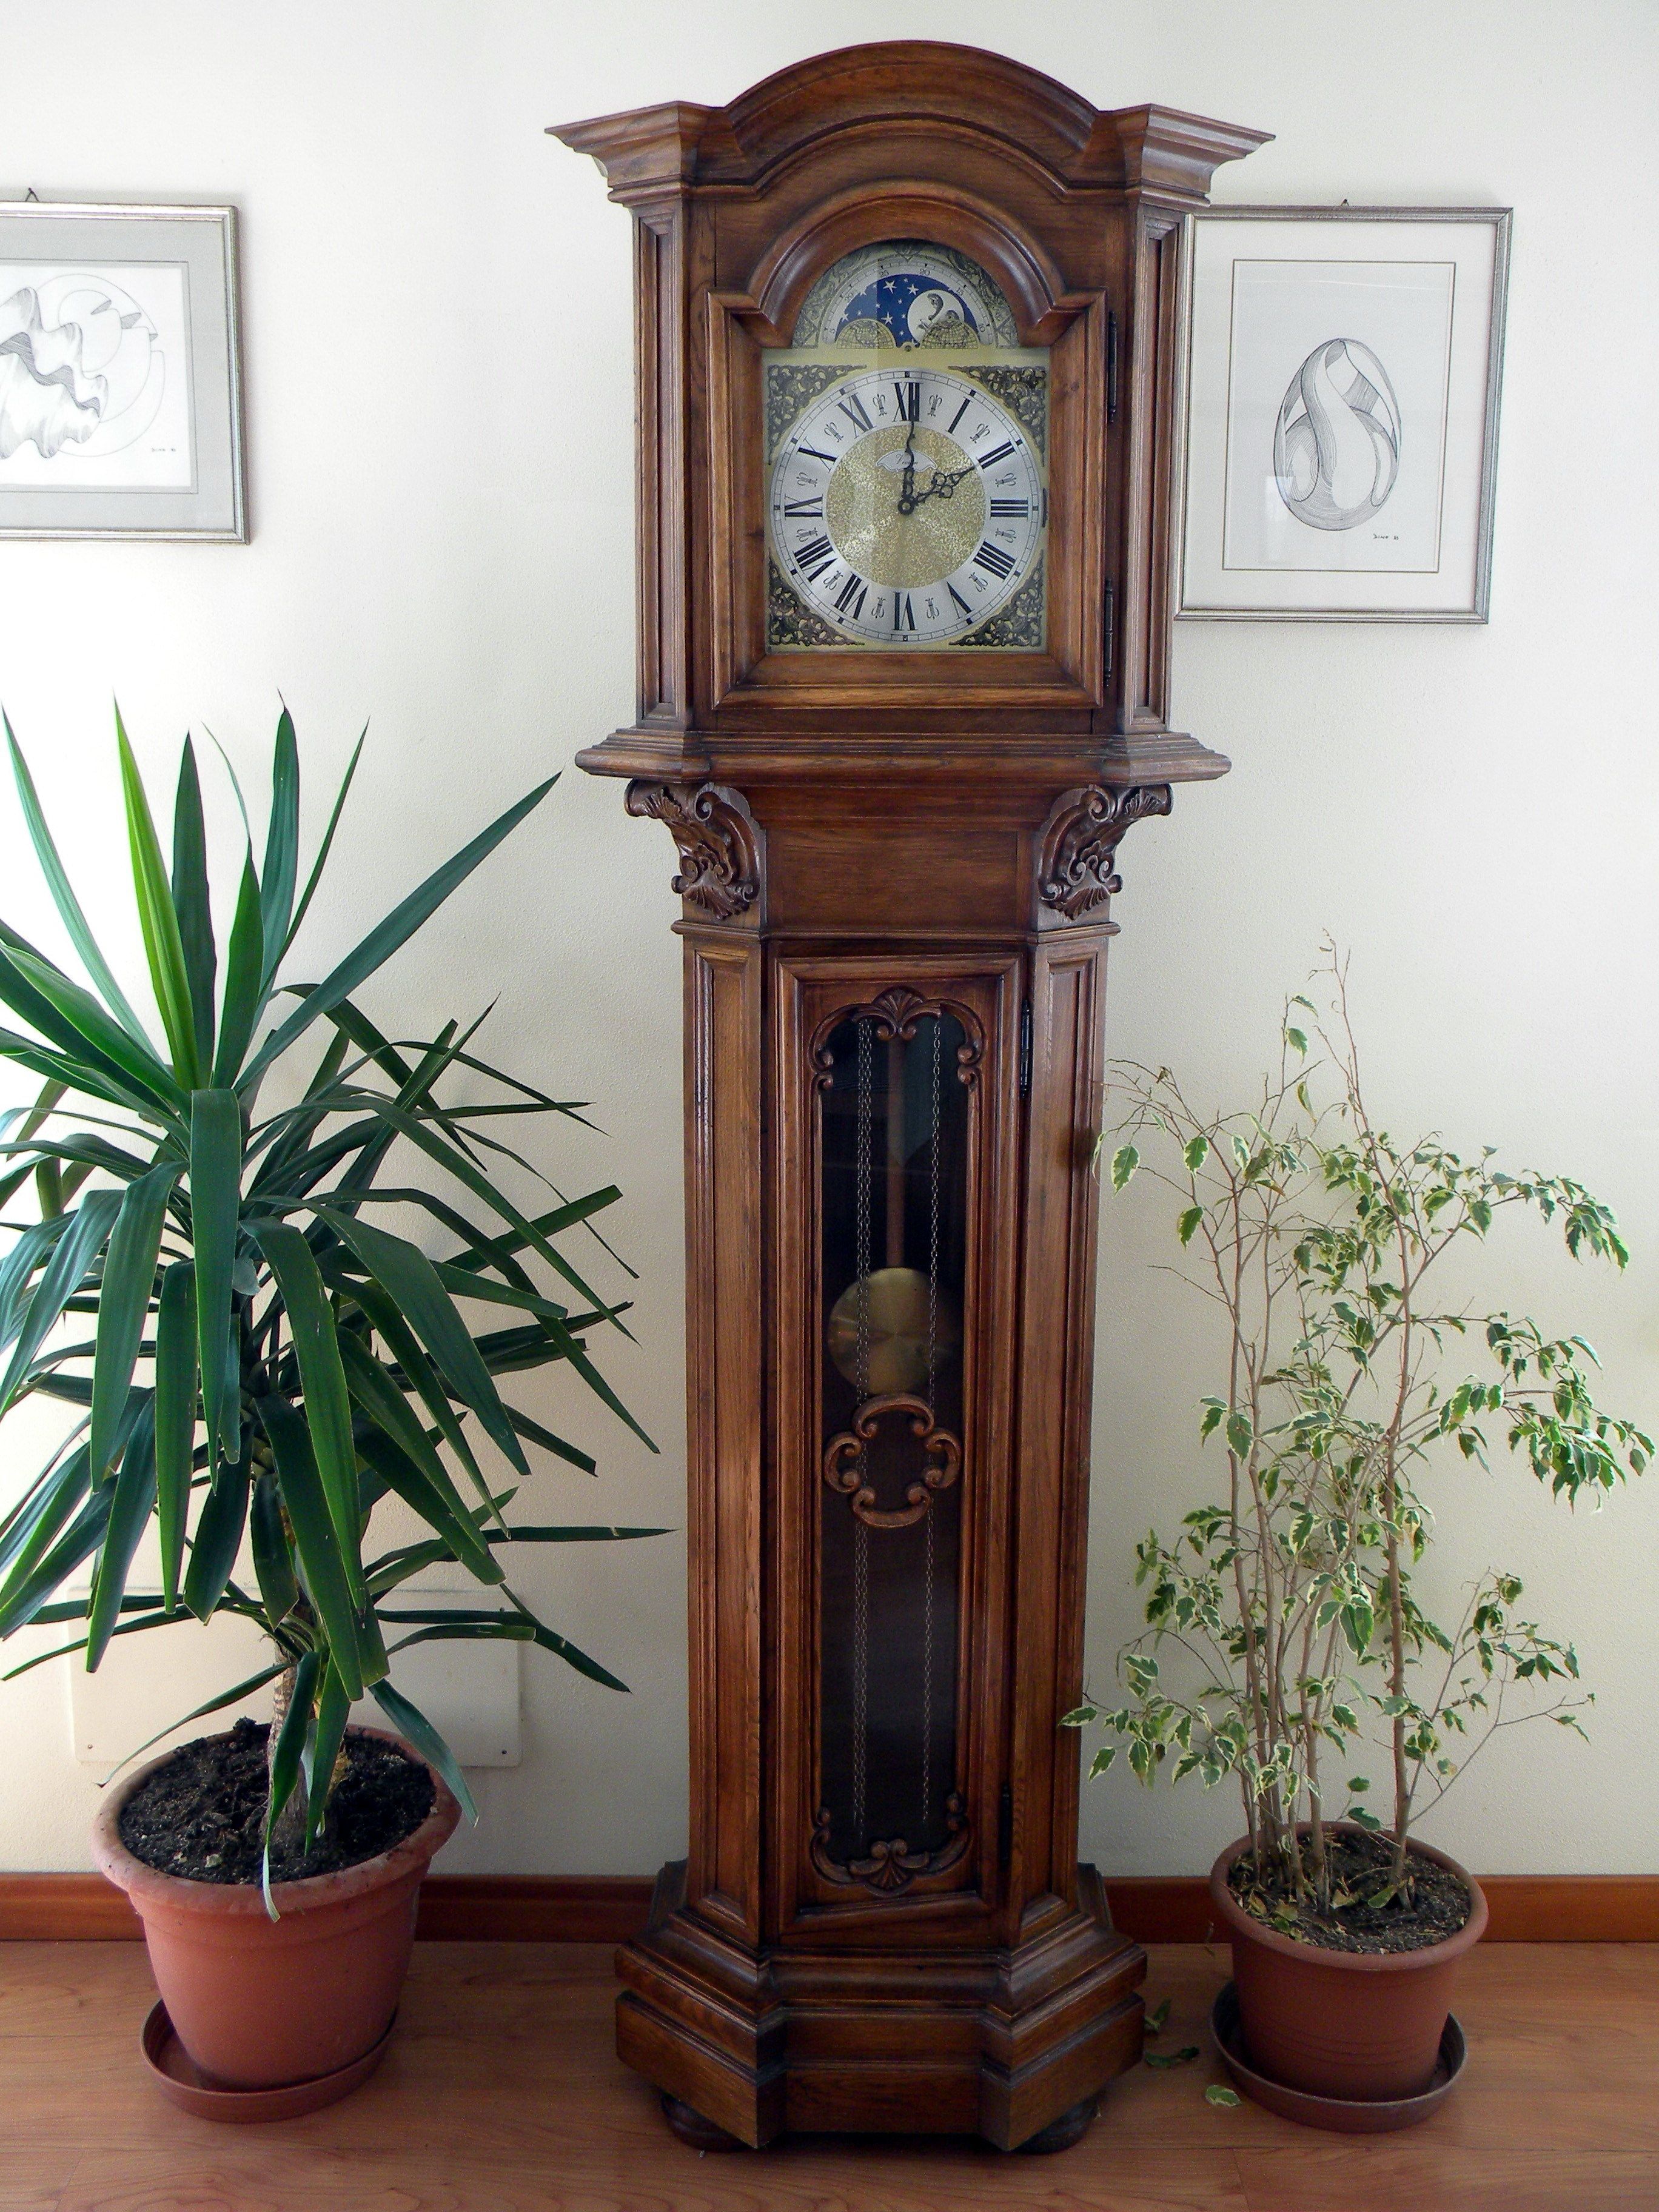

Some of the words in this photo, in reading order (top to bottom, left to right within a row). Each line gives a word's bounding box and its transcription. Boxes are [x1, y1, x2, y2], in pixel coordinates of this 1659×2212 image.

[956, 287, 964, 296] 15
[834, 392, 877, 439] XI
[891, 381, 923, 423] XII
[945, 396, 973, 435] I
[796, 436, 839, 473] X
[976, 438, 1017, 473] II
[784, 493, 824, 520] IX
[990, 496, 1028, 521] III
[792, 532, 838, 586] VIII
[971, 538, 1017, 583] IIII
[831, 571, 870, 622] VII
[893, 591, 918, 631] VI
[946, 580, 975, 620] V
